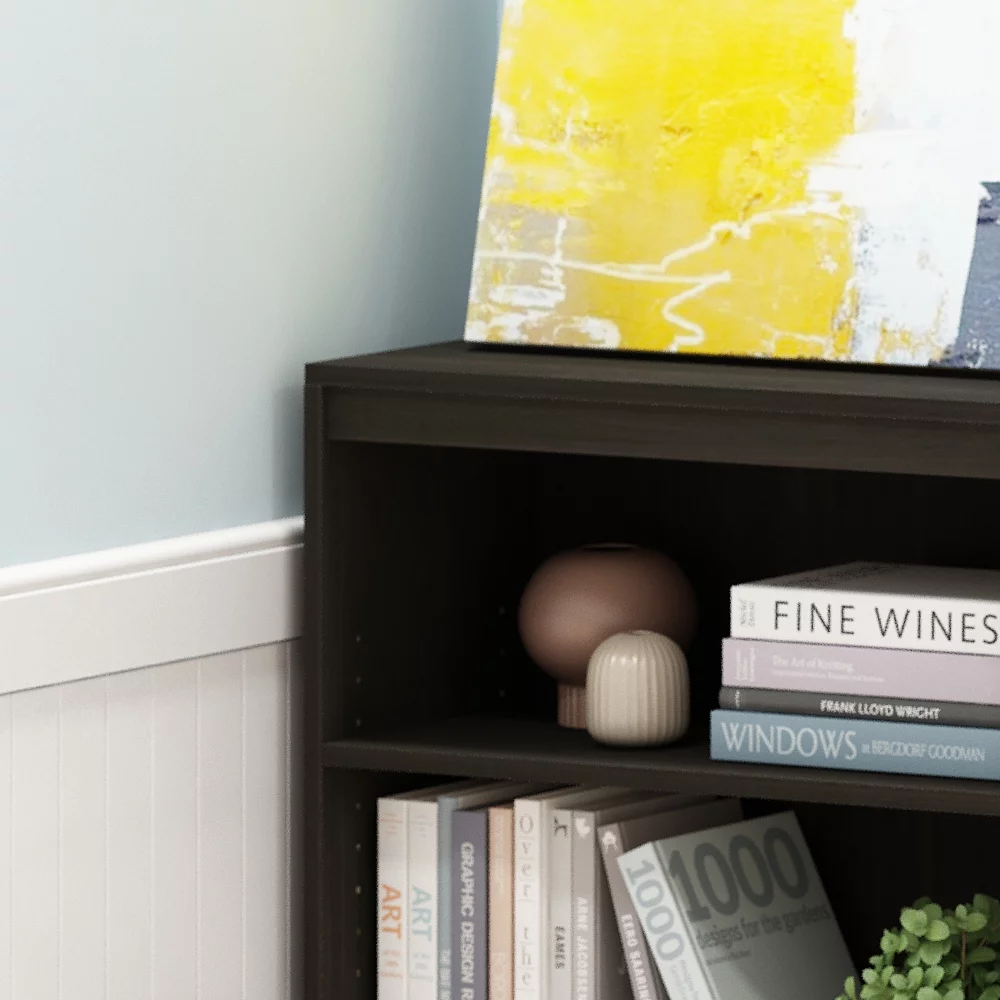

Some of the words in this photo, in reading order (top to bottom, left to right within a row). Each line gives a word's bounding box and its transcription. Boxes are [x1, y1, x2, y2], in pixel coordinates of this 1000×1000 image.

[774, 600, 855, 636] FINE
[875, 606, 999, 645] WINES
[820, 699, 855, 716] FRANK
[857, 703, 894, 719] LLOYD
[895, 704, 942, 721] WRIGHT
[720, 721, 857, 761] WINDOWS
[928, 743, 986, 763] GOODMAN
[460, 841, 475, 918] GRAPHIC
[667, 826, 809, 922] 1000
[380, 883, 402, 940] ART
[411, 885, 433, 942] ART
[576, 896, 588, 932] ARNE
[620, 913, 639, 949] EERO
[626, 858, 685, 961] 1000
[460, 920, 475, 984] DESIGN
[554, 925, 566, 970] EAMES
